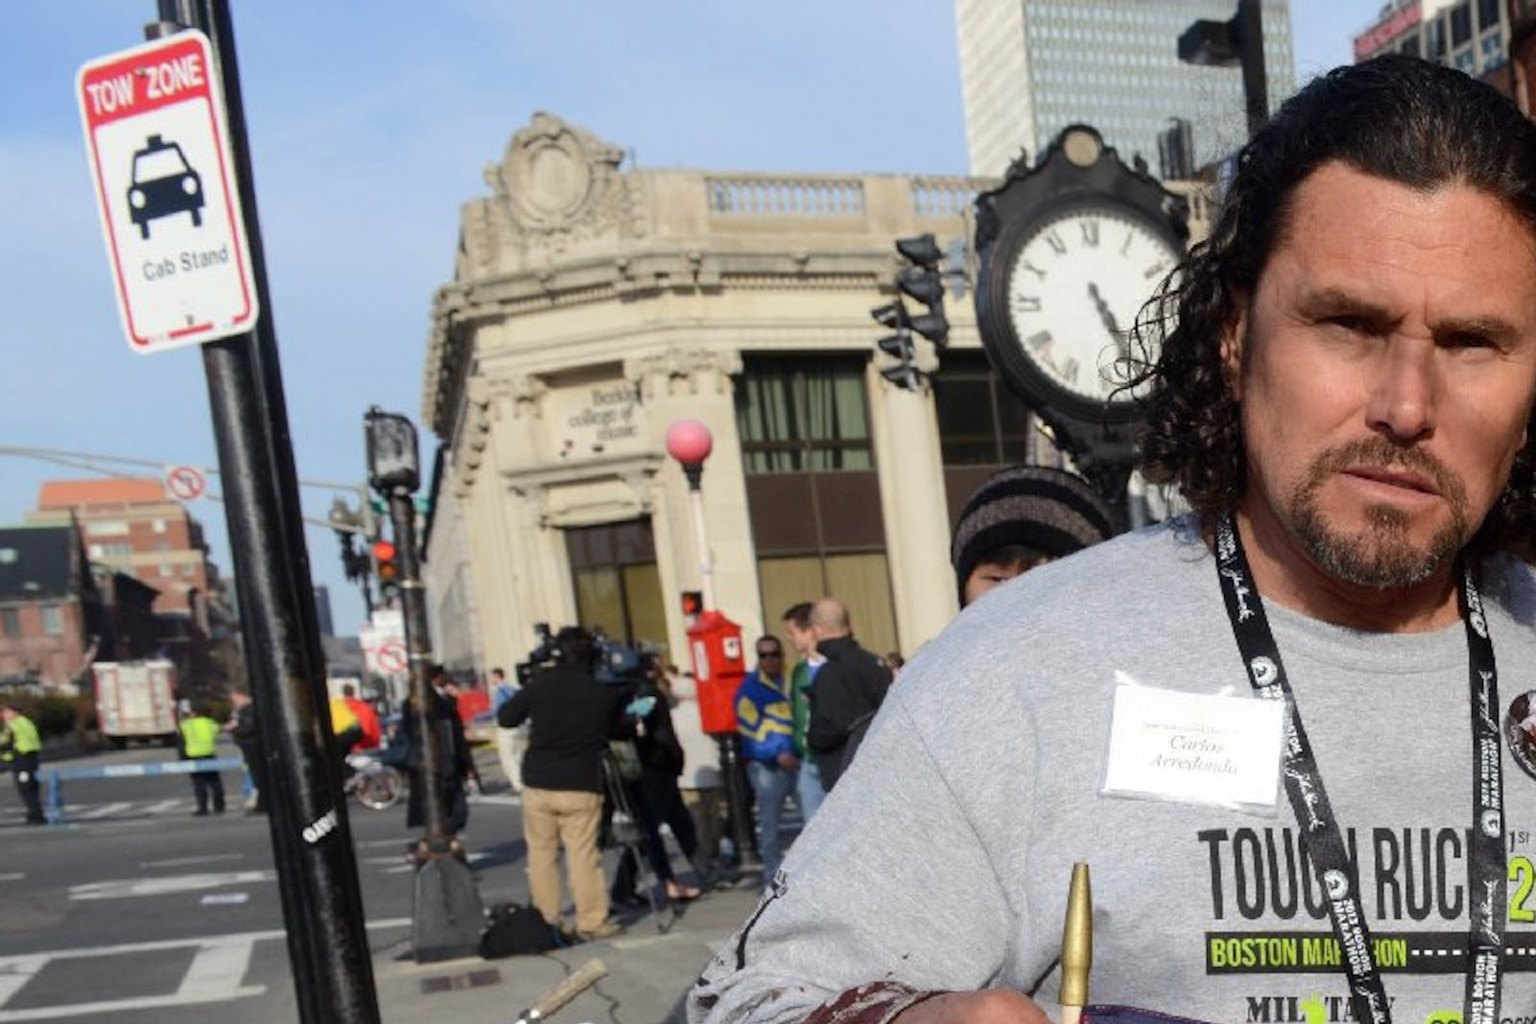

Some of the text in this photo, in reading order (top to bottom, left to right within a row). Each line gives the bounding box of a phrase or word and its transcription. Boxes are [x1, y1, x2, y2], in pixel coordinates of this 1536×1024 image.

[86, 53, 204, 115] TOW ZONE
[142, 243, 228, 280] Cab Stand
[1150, 754, 1237, 775] Arredondo
[1170, 735, 1223, 753] Carlos
[1372, 827, 1472, 920] RUC
[1210, 938, 1407, 967] BOSTON MARHON
[1332, 901, 1364, 976] MARATHON
[1353, 926, 1373, 972] BOSTON
[1472, 954, 1487, 999] BOSTON
[1246, 996, 1396, 1023] MILTA
